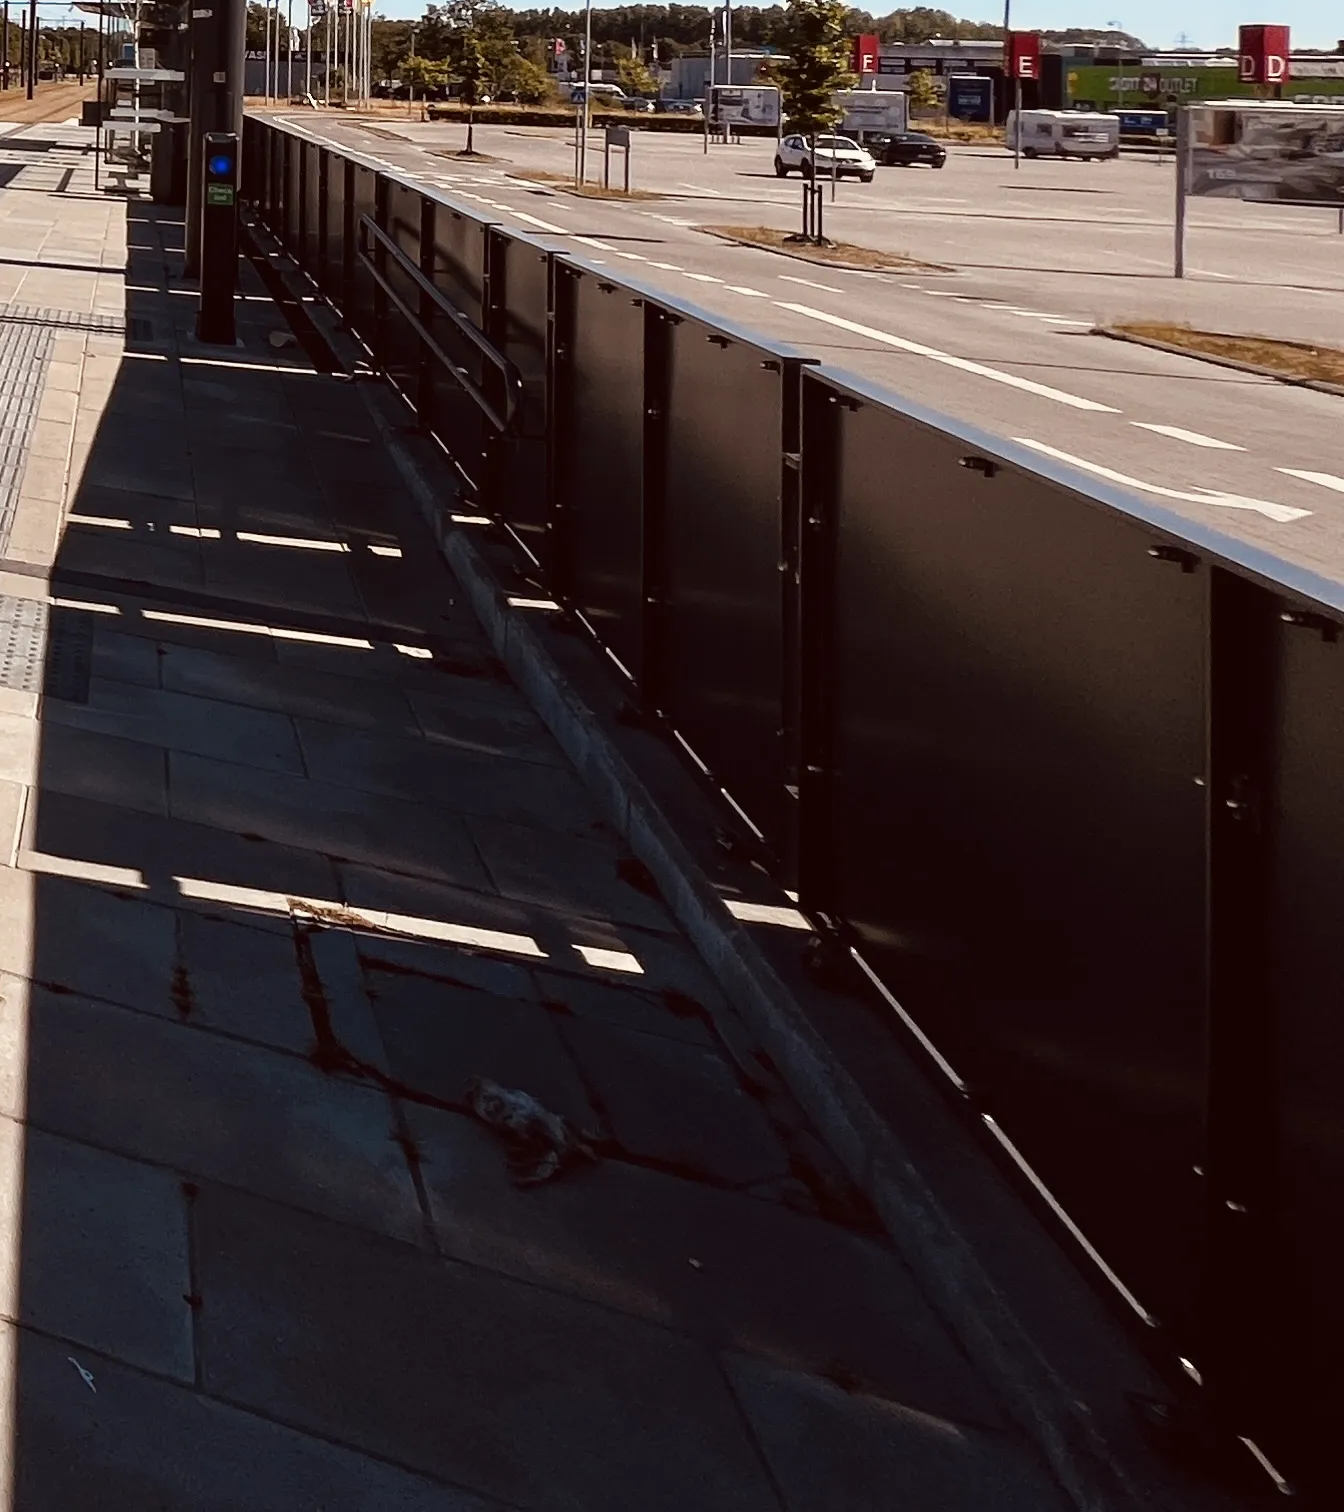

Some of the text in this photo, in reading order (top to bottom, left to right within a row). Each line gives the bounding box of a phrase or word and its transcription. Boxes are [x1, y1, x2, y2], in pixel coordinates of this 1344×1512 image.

[1019, 56, 1033, 74] E
[1240, 55, 1255, 76] D
[1268, 55, 1285, 77] D
